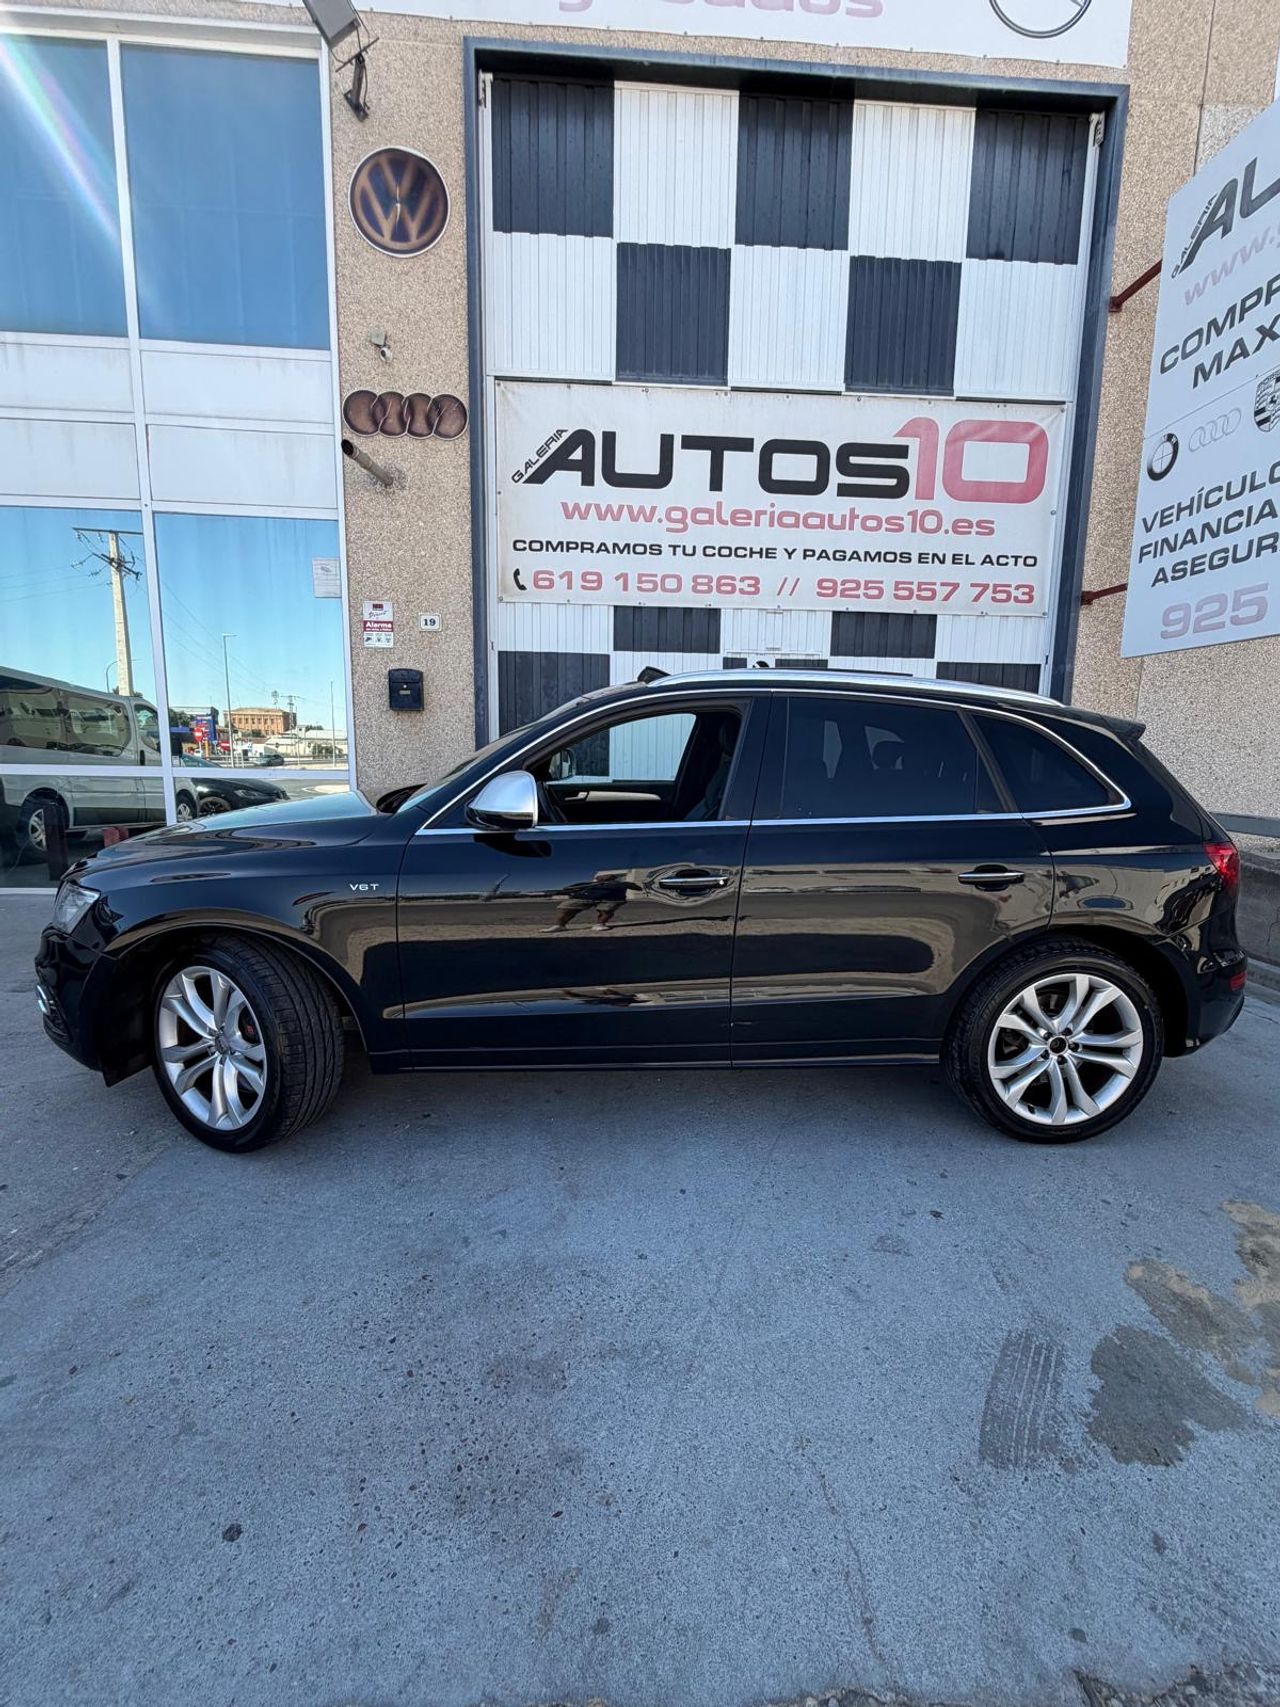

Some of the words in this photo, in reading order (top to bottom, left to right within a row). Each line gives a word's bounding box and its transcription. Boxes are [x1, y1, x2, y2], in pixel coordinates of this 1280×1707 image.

[1185, 221, 1280, 306] www.
[511, 429, 569, 484] GALERIA
[560, 501, 996, 536] www.galeriaautos10.es
[512, 539, 663, 556] COMPRAMOS
[668, 544, 697, 557] TU
[702, 545, 778, 560] COCHE
[783, 548, 798, 560] Y
[802, 549, 913, 564] PAGAMOS
[917, 552, 947, 565] EN
[951, 553, 976, 566] EL
[980, 554, 1038, 568] ACTO
[532, 569, 604, 591] 619
[614, 572, 683, 594] 150
[691, 574, 761, 596] 863
[816, 577, 885, 600] 925
[893, 580, 961, 602] 557
[969, 582, 1036, 605] 753
[423, 618, 437, 627] 19
[1160, 582, 1269, 640] 925
